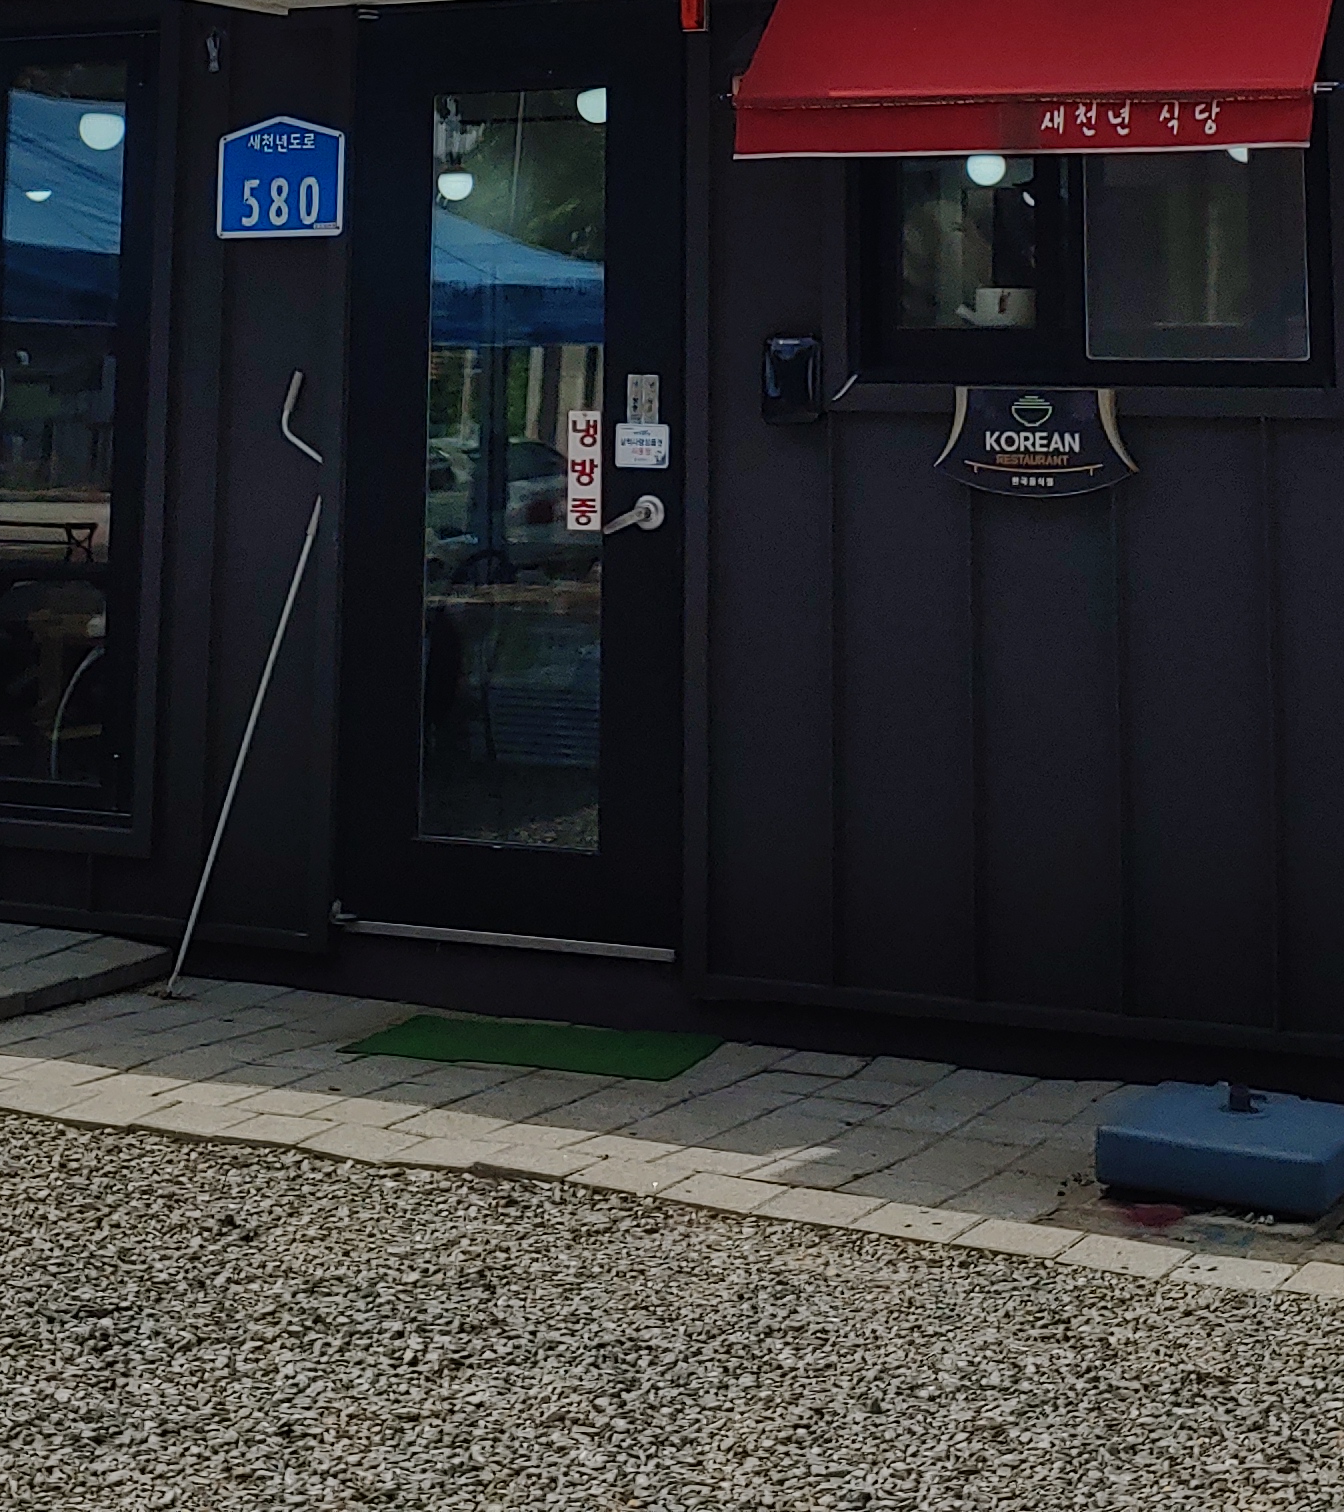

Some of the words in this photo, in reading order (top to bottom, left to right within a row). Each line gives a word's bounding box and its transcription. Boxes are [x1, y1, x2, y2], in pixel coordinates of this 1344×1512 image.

[1040, 99, 1131, 137] 새천년
[1159, 99, 1221, 136] 식당
[247, 133, 316, 153] 새천년도로
[241, 176, 320, 228] 580
[985, 431, 1080, 454] KOREAN
[570, 418, 598, 526] 냉방중
[996, 454, 1069, 466] RESTAURANT
